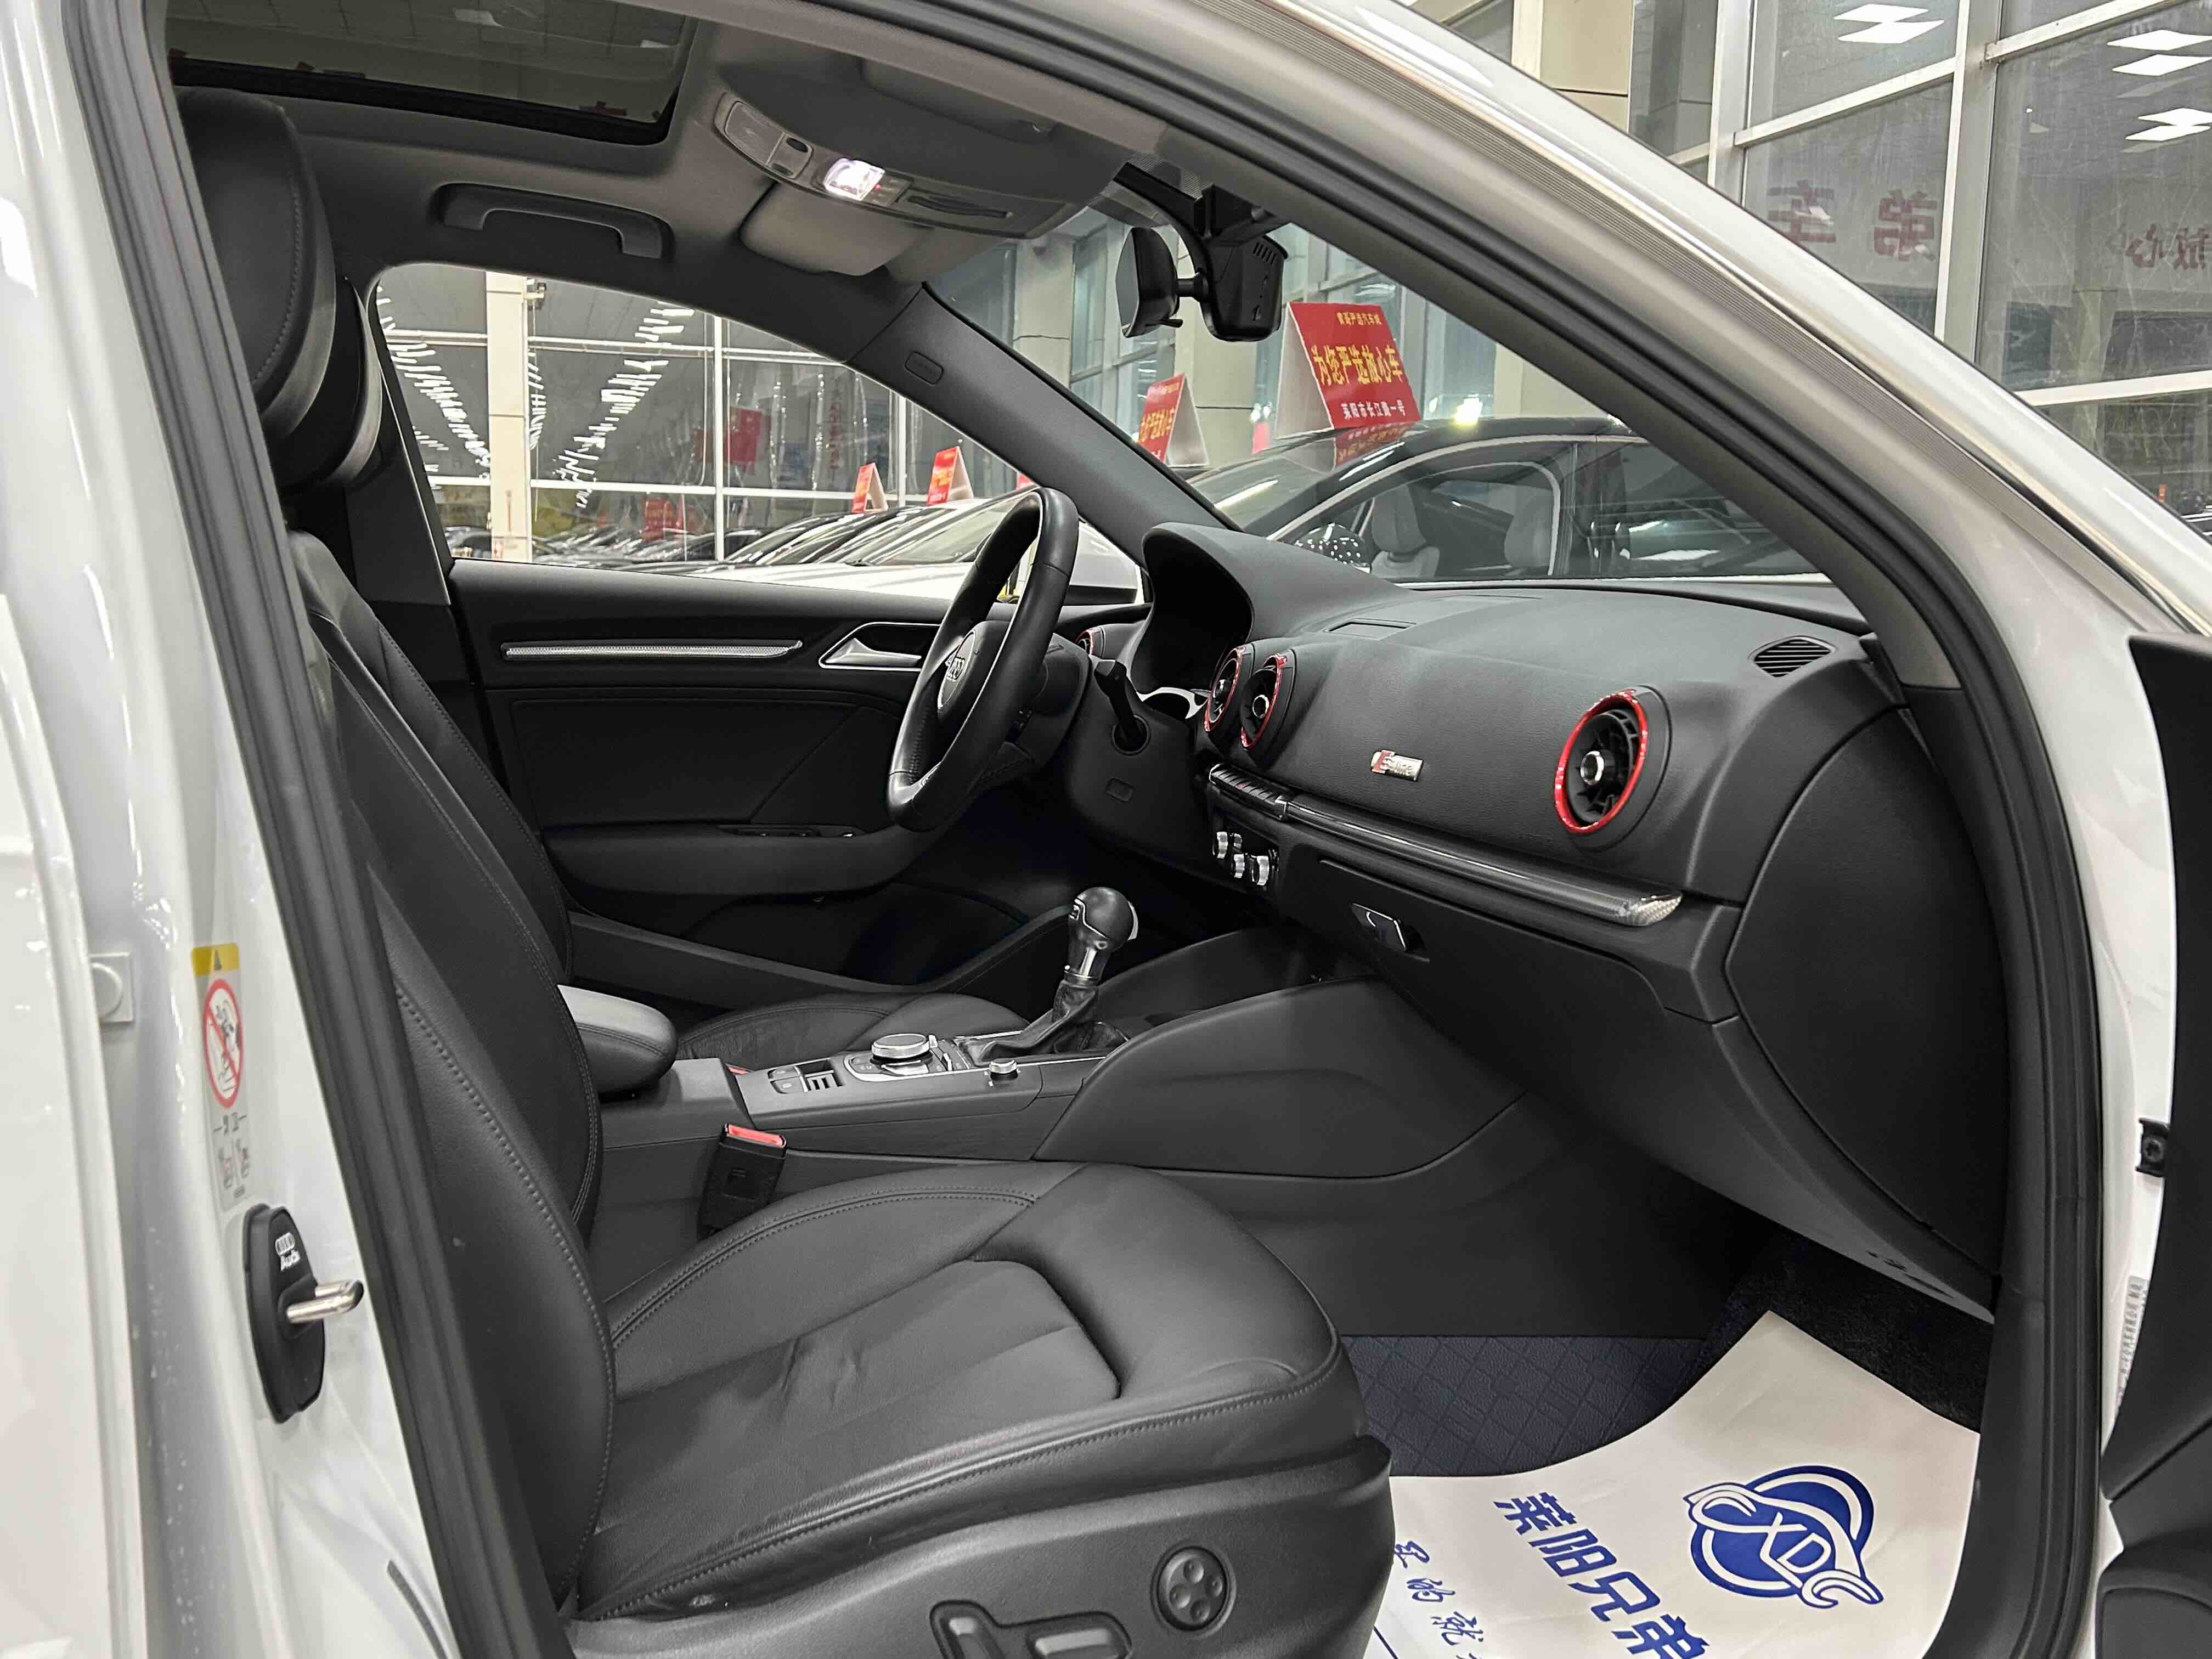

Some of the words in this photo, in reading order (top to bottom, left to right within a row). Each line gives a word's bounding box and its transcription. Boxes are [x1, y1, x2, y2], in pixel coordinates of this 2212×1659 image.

[1310, 344, 1403, 386] 为您严选放心车
[1340, 399, 1406, 420] 莱阳市长江路一号
[1493, 1492, 1710, 1659] 莱阳兄弟
